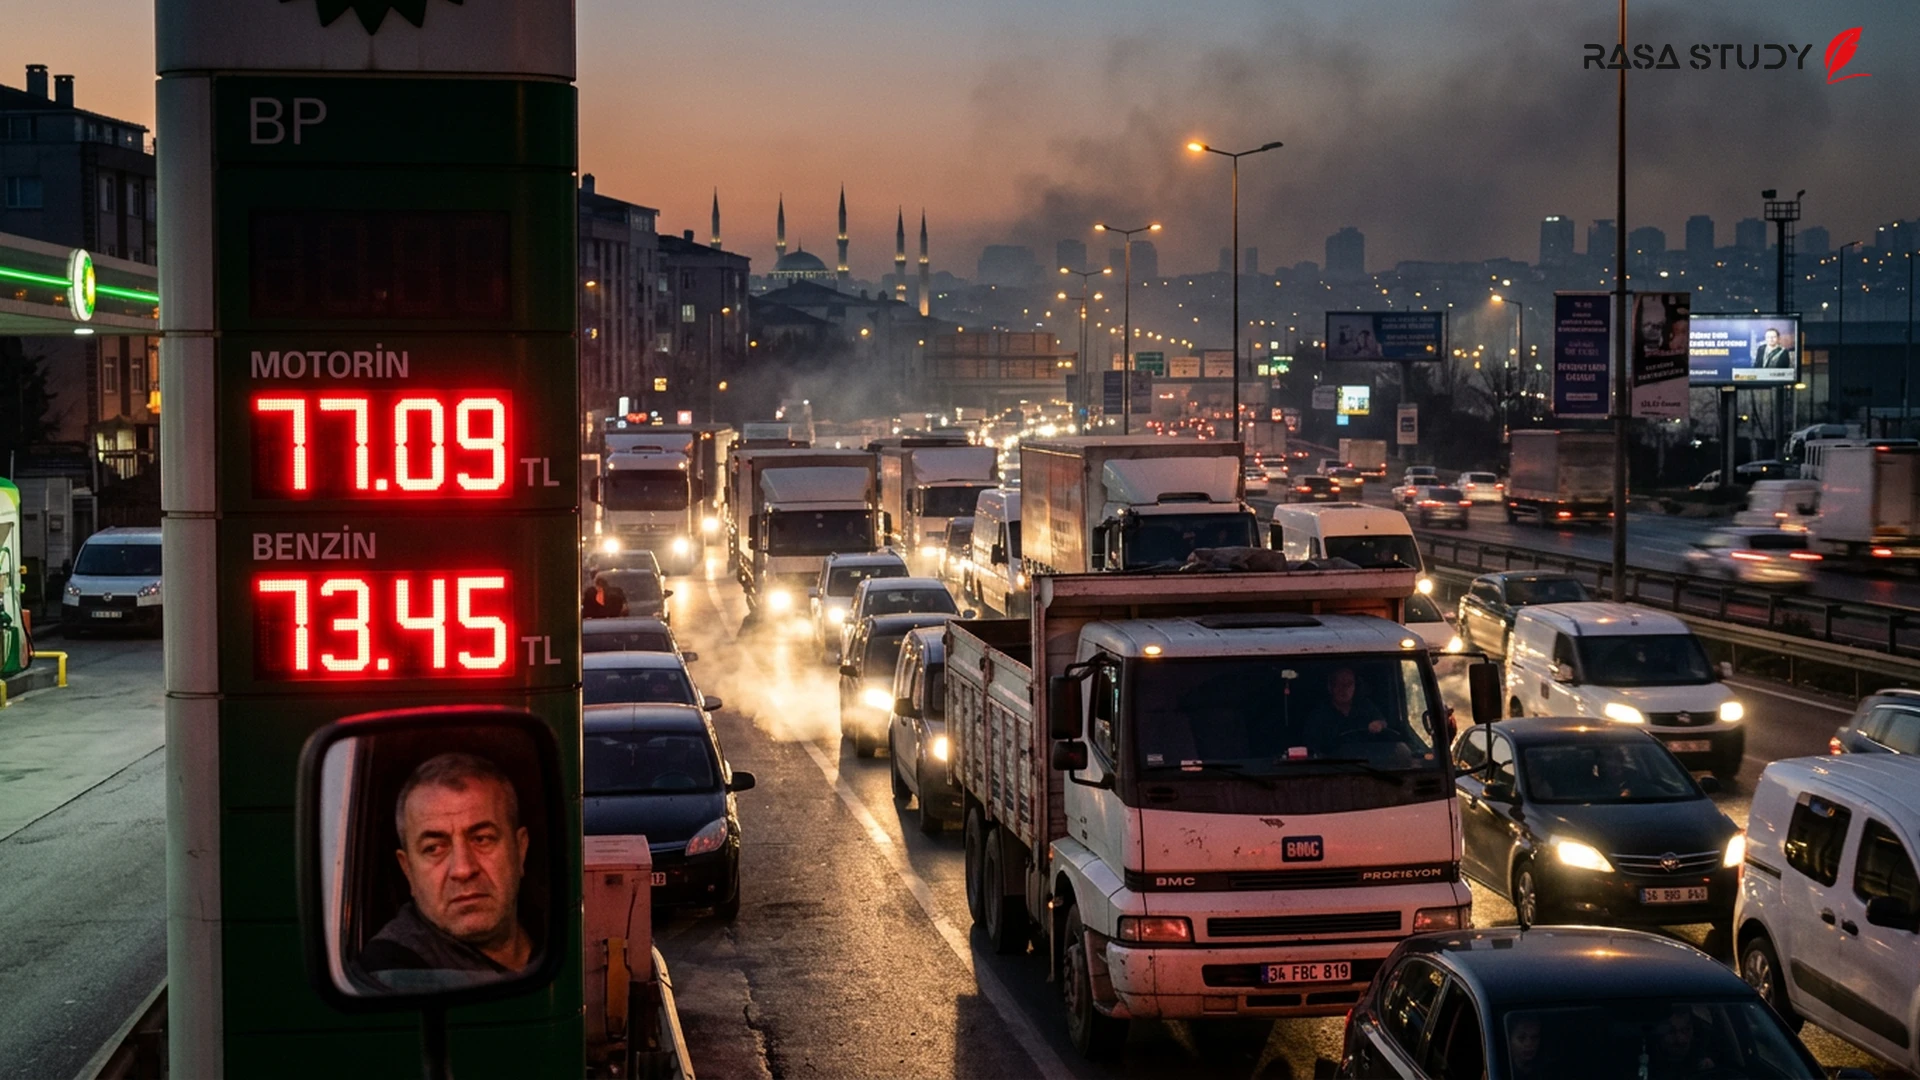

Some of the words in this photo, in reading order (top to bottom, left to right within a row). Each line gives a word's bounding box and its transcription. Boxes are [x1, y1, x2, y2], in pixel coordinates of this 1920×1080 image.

[250, 97, 327, 145] BP
[251, 343, 409, 378] MOTORİN
[257, 397, 506, 491] 77.09
[520, 457, 560, 487] TL
[253, 525, 376, 560] BENZİN
[259, 576, 507, 671] 73.45
[521, 636, 561, 666] TL
[1292, 965, 1318, 980] FBC
[1323, 963, 1349, 979] 819
